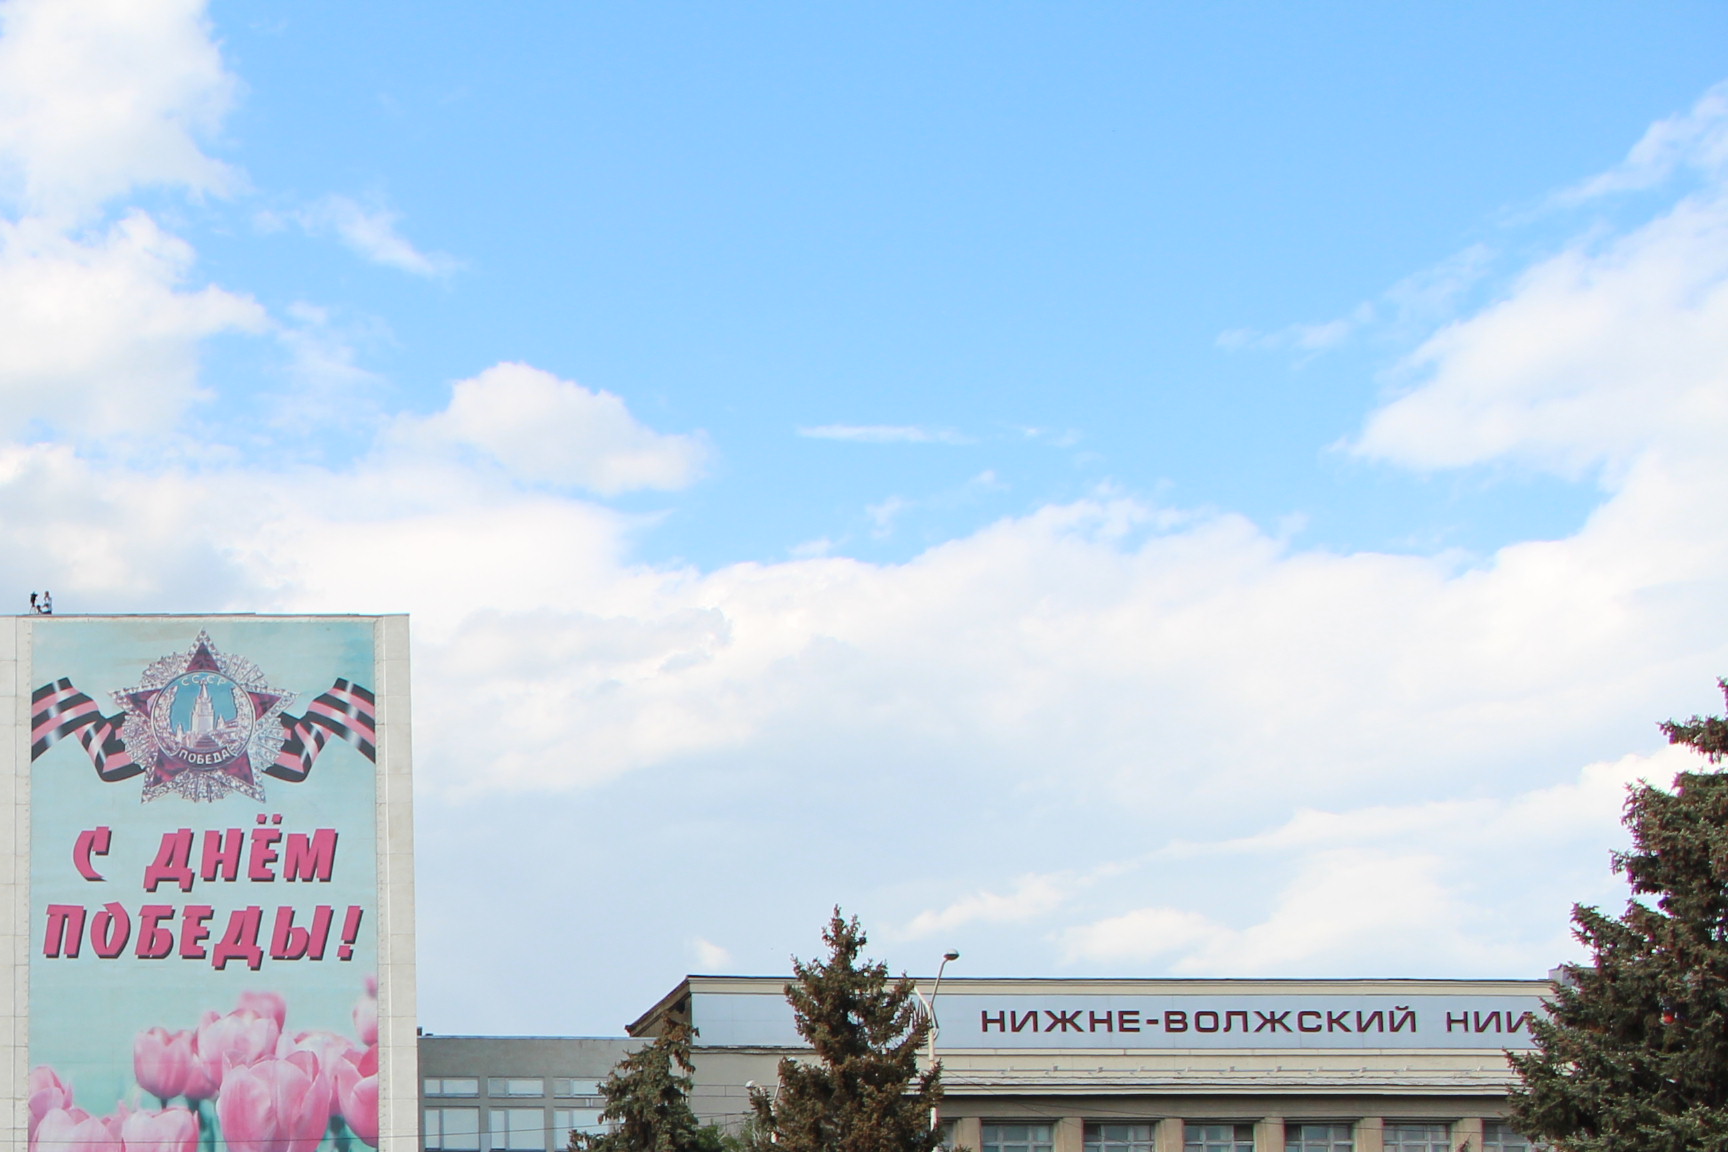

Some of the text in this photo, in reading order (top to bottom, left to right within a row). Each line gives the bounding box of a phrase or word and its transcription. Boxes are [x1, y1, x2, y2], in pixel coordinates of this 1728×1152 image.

[179, 749, 231, 766] ПОБЕДА
[73, 813, 338, 893] С ДНЁМ
[42, 901, 363, 971] ПОБЕДЫ!
[980, 1005, 1417, 1033] НИЖНЕ-ВОЛЖСКИЙ
